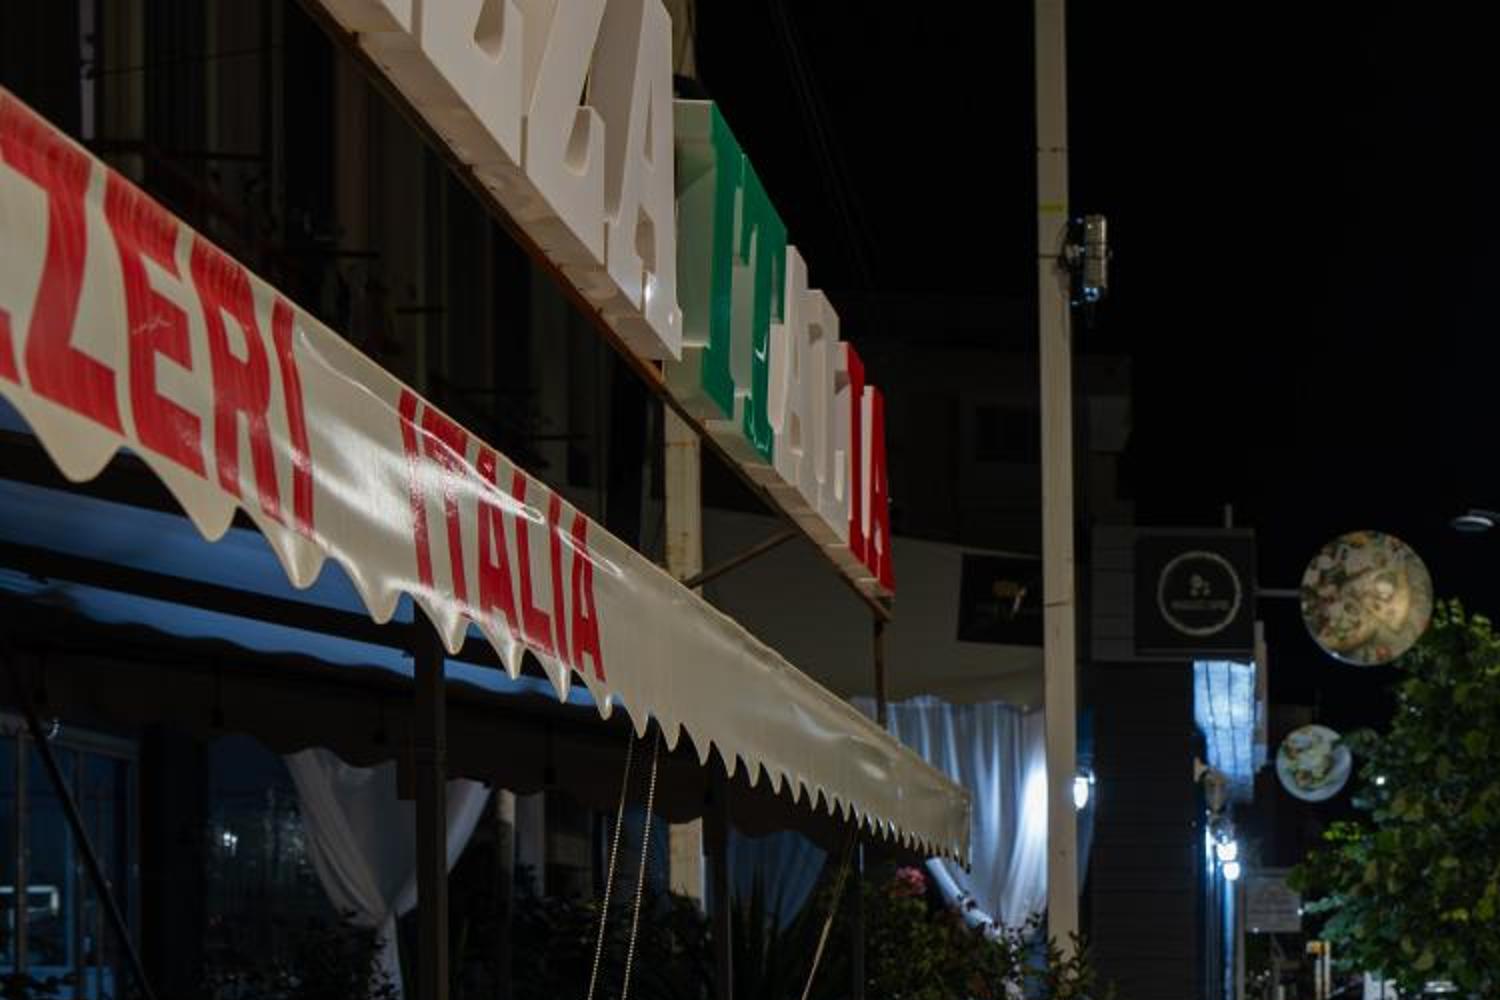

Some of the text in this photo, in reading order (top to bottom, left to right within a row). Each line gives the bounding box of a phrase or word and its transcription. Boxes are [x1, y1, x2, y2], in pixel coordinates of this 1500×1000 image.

[0, 87, 607, 683] ZERI ITALIA
[690, 100, 896, 594] ITALIA
